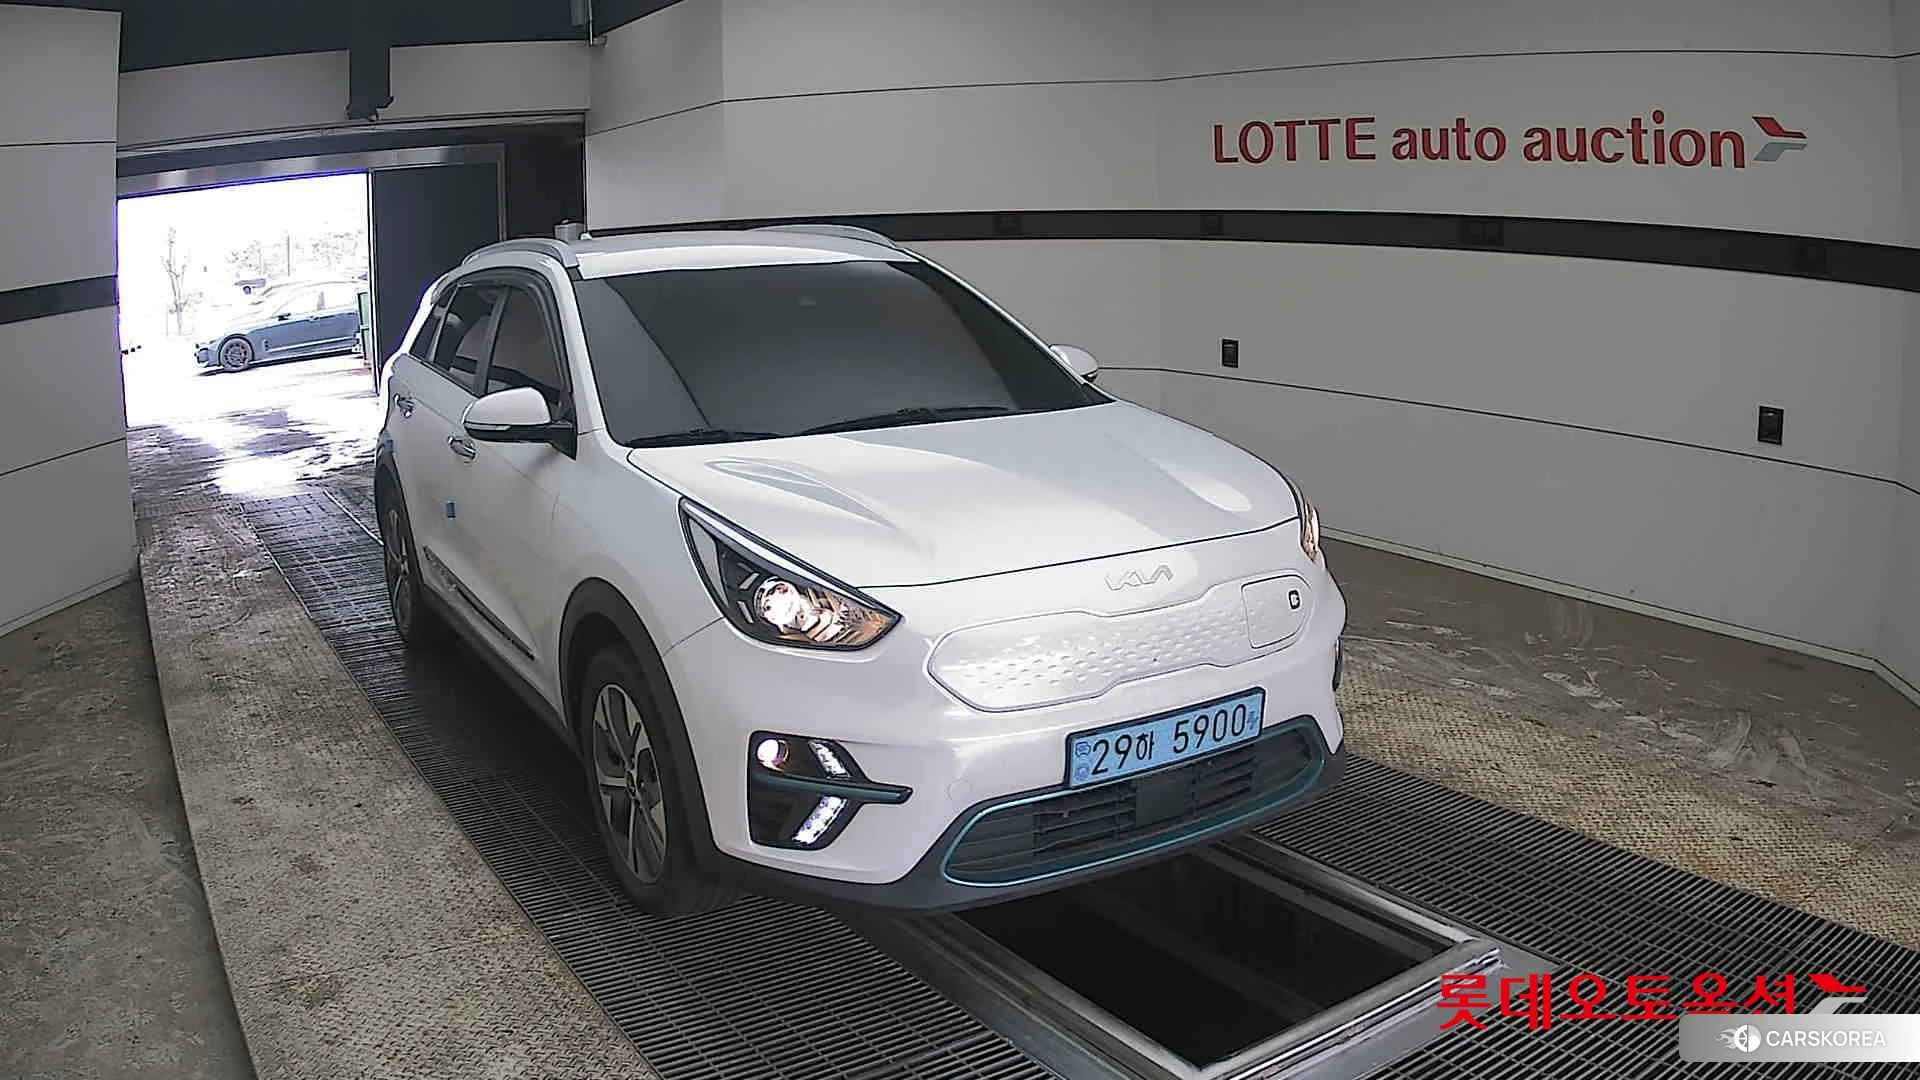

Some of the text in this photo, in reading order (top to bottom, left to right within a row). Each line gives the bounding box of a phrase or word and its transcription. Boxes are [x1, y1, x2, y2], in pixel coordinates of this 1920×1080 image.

[1213, 110, 1745, 168] LOTTE auto auction
[1105, 565, 1173, 590] KIA
[1092, 704, 1246, 775] 29하 5900
